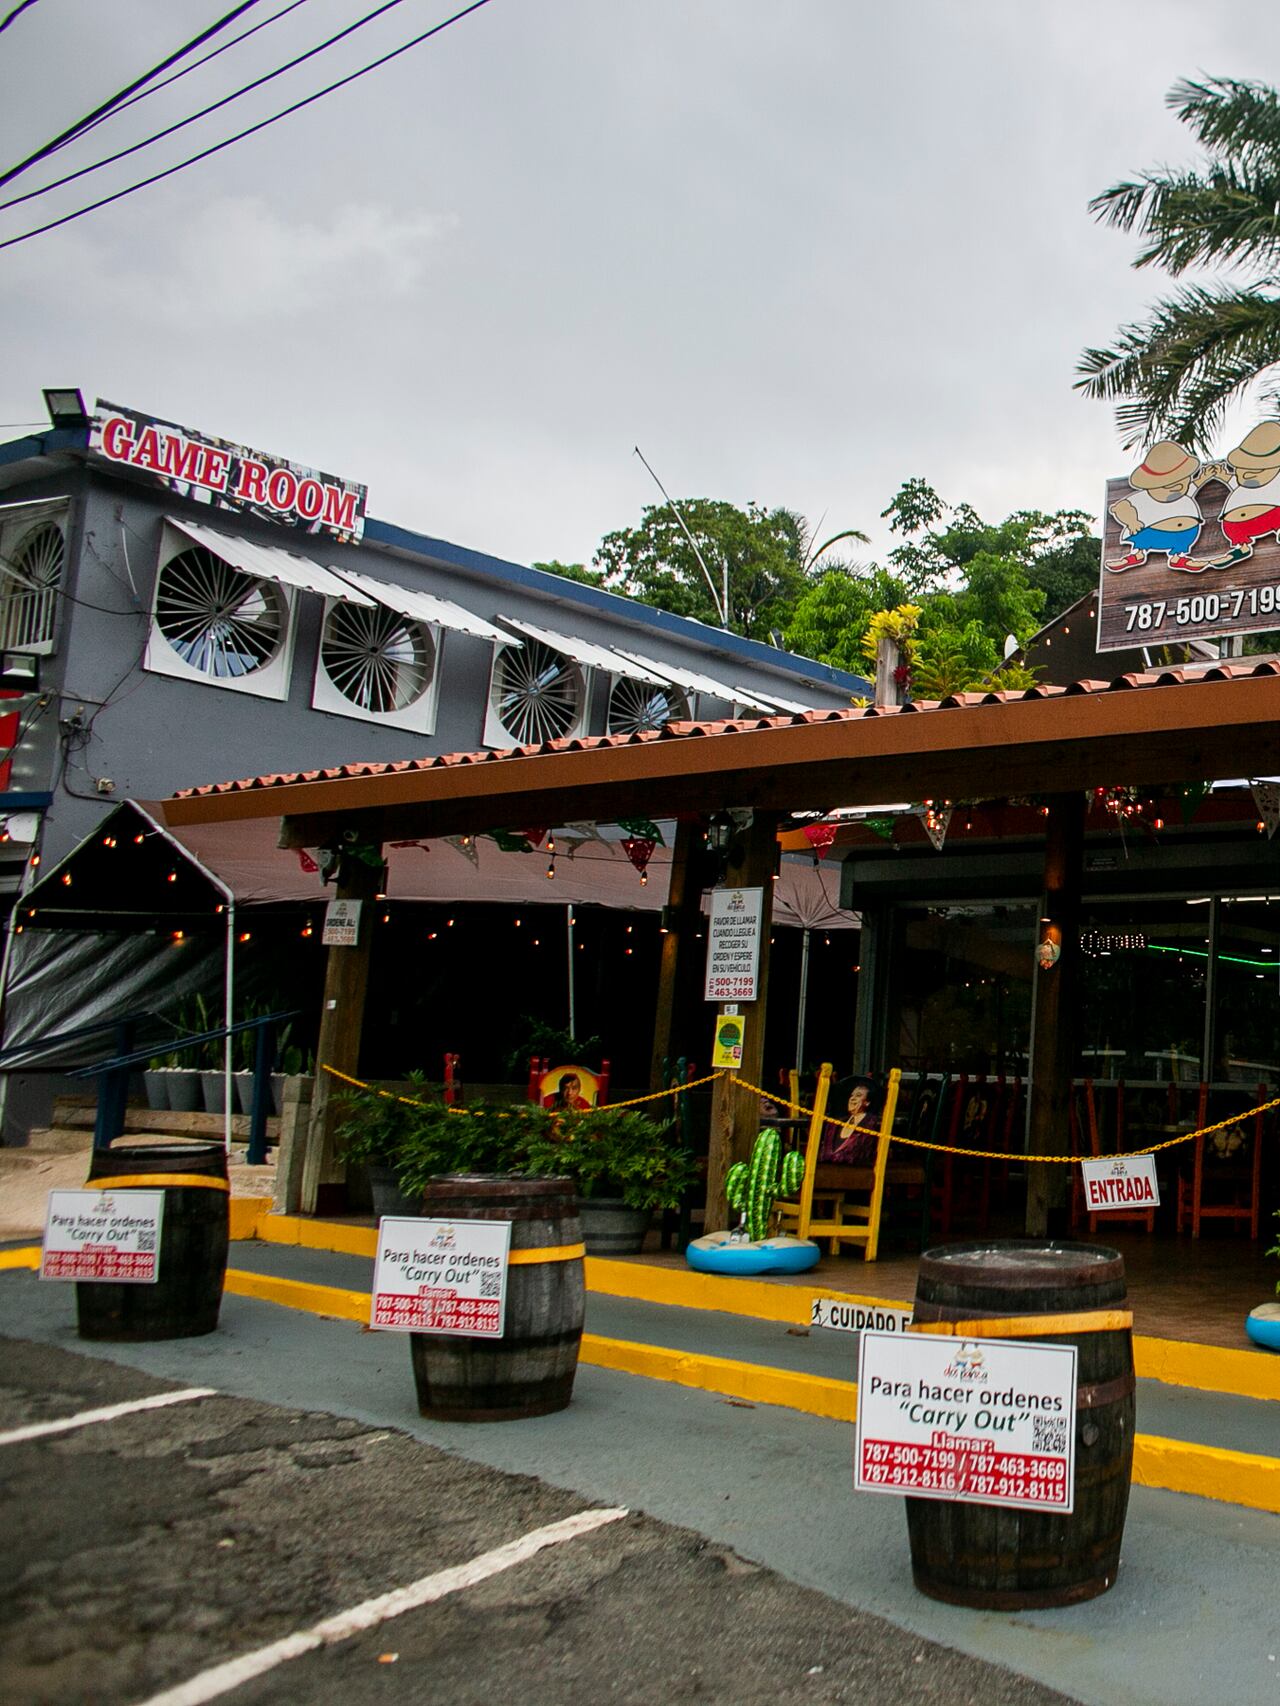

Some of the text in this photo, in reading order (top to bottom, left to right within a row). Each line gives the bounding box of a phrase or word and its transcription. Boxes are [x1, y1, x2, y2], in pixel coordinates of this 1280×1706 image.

[102, 417, 360, 532] GAME ROOM
[714, 915, 757, 925] FAVOR DE LLAMAR
[713, 928, 733, 938] CUANDO
[734, 928, 752, 938] LLEGUE
[719, 939, 748, 949] RECOGER SU
[713, 952, 730, 961] ORDEN
[734, 951, 753, 961] ESPERE
[712, 964, 719, 973] EN
[720, 964, 727, 973] SU
[715, 977, 754, 986] 500-7199
[714, 987, 753, 997] 463-3669
[1089, 1176, 1154, 1204] ENTRADA
[51, 1214, 154, 1228] Para hacer ordenes
[384, 1249, 500, 1268] Para hacer ordenes
[441, 1301, 500, 1316] 787-463-3669
[376, 1310, 433, 1327] 787-912-8116
[440, 1314, 499, 1331] 787-912-8115
[830, 1305, 896, 1332] CUIDADO
[870, 1377, 1063, 1411] Para hacer ordenes
[931, 1431, 994, 1454] Llamar:
[864, 1442, 955, 1470] 787-500-7199
[969, 1454, 1065, 1481] 787-463-3669
[864, 1464, 956, 1489] 787-912-8116
[969, 1475, 1064, 1501] 787-912-8115
